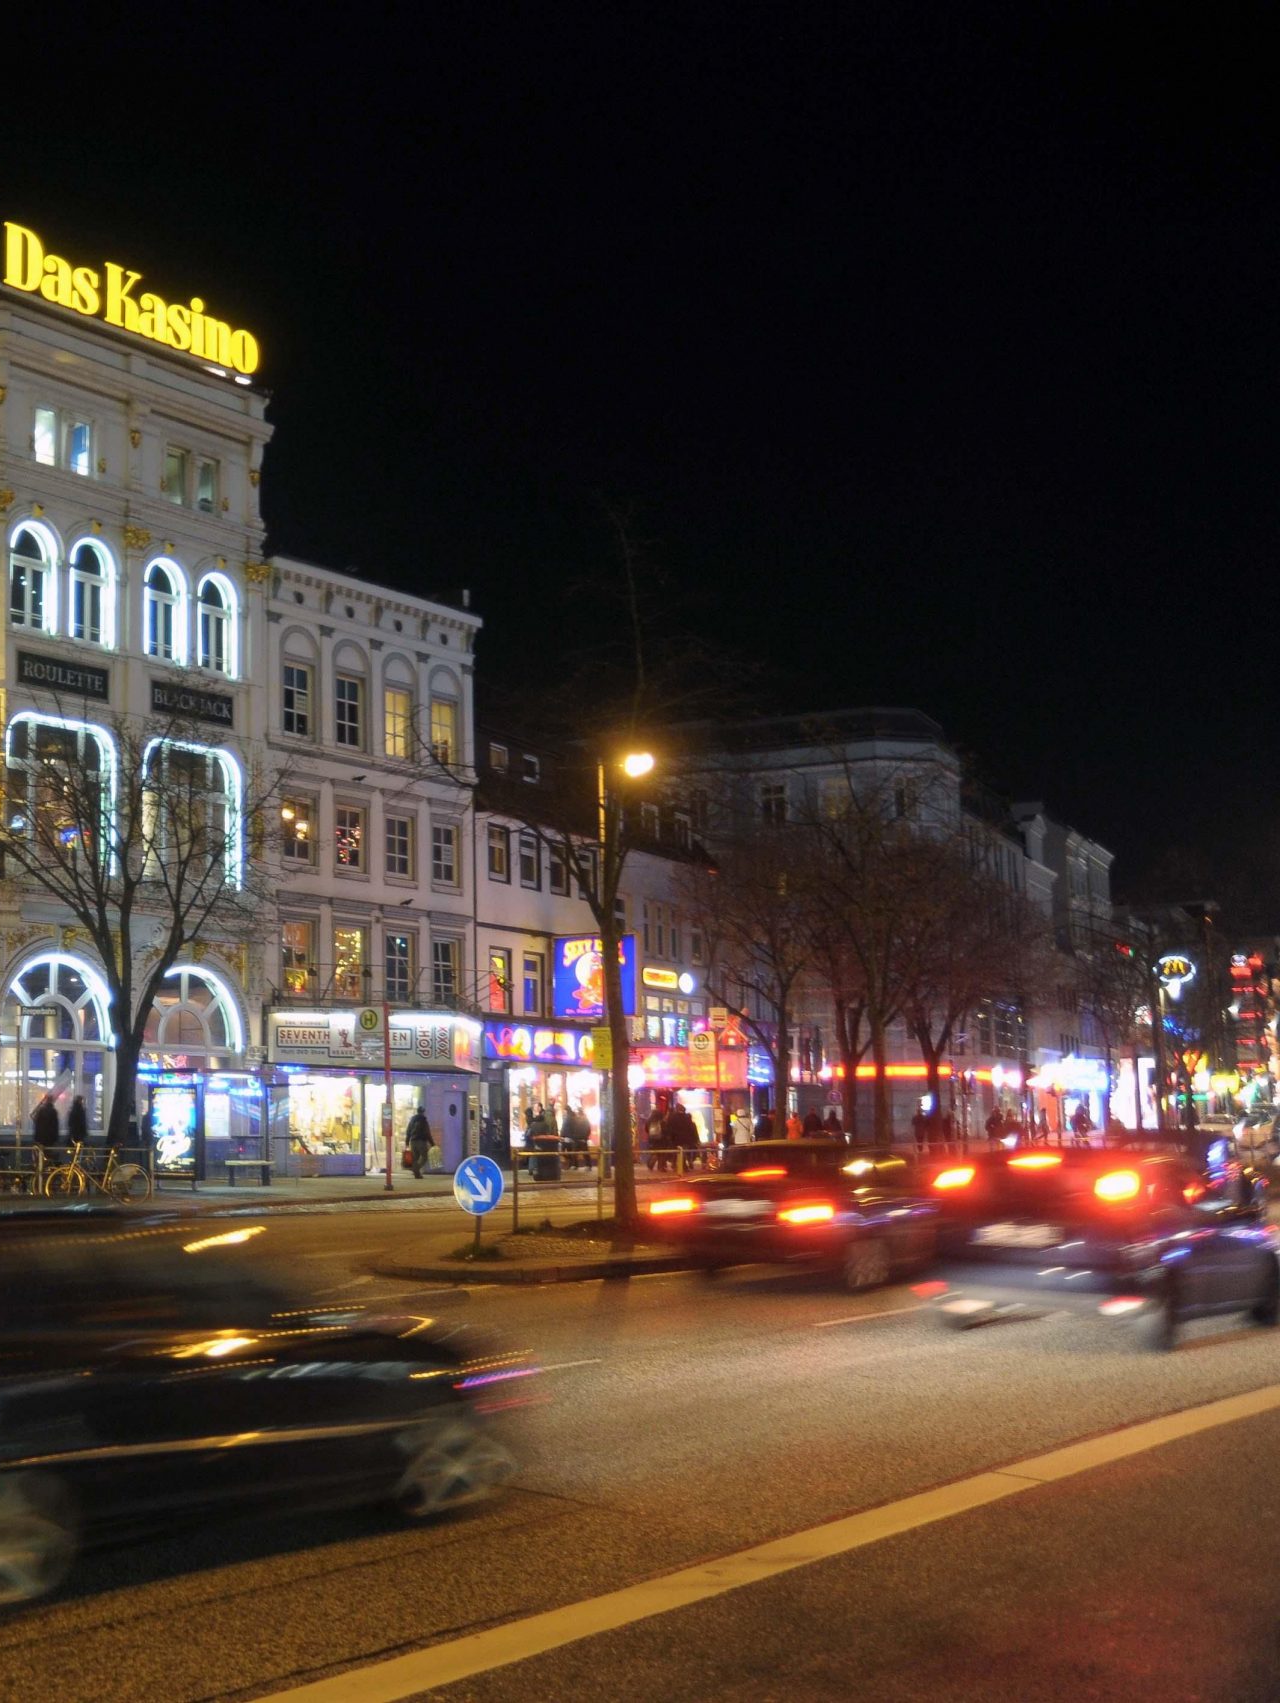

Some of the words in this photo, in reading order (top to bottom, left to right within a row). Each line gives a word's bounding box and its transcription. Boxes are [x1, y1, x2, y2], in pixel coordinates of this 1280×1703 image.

[3, 221, 101, 316] Das
[104, 262, 260, 374] Kasino
[23, 660, 104, 692] ROULETTE
[279, 1029, 331, 1040] SEVENTH
